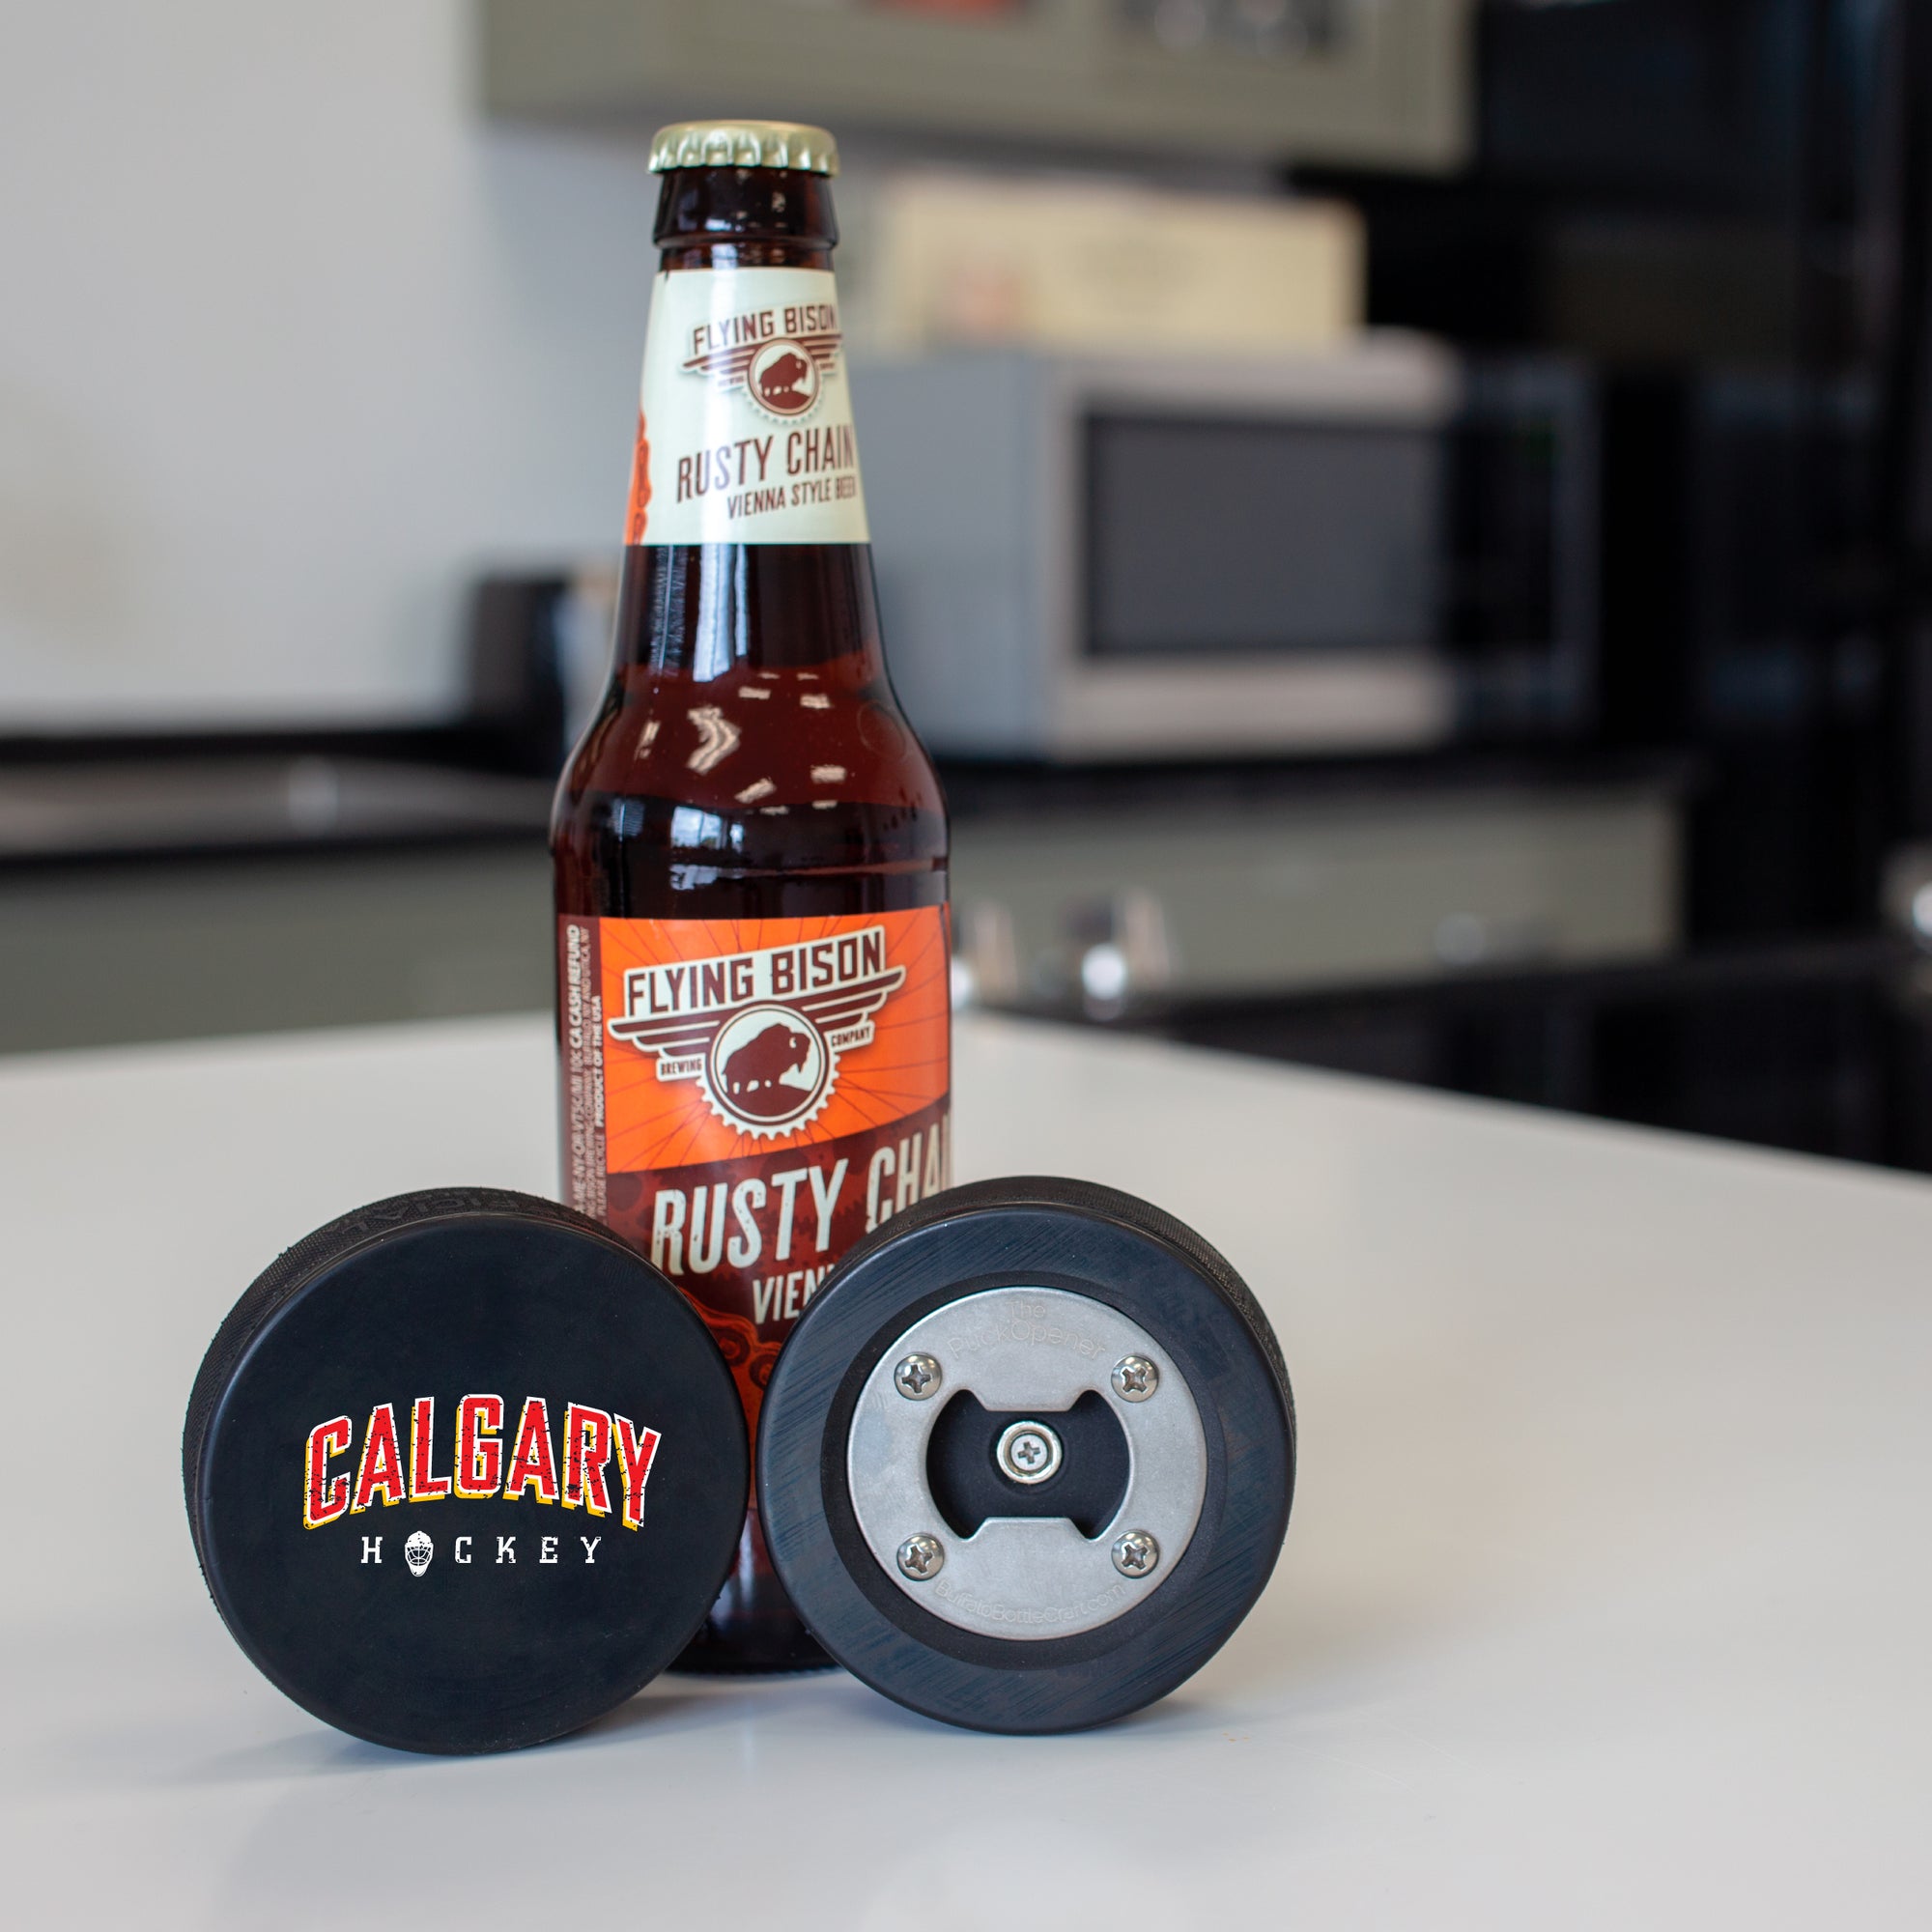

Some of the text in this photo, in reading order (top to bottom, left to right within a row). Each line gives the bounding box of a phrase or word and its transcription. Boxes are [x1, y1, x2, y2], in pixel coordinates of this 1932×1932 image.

[693, 303, 838, 354] FLYING BISON
[677, 425, 854, 503] RUSTY CHAIN
[727, 486, 786, 520] VIENNA
[791, 479, 831, 506] STYLE
[567, 924, 581, 985] REFUND
[627, 930, 885, 1017] FLYING BISON
[568, 985, 582, 1026] CASH
[591, 996, 602, 1022] USA
[569, 1027, 582, 1049] CA
[592, 1023, 604, 1046] THE
[831, 1025, 871, 1047] COMPANY
[593, 1048, 604, 1066] OF
[660, 1057, 703, 1076] BREWING
[593, 1067, 605, 1127] PRODUCT
[650, 1158, 849, 1276] RUSTY
[753, 1263, 836, 1324] VIEN
[1005, 1298, 1046, 1320] The
[303, 1394, 662, 1532] CALGARY
[360, 1532, 602, 1571] HCKEY
